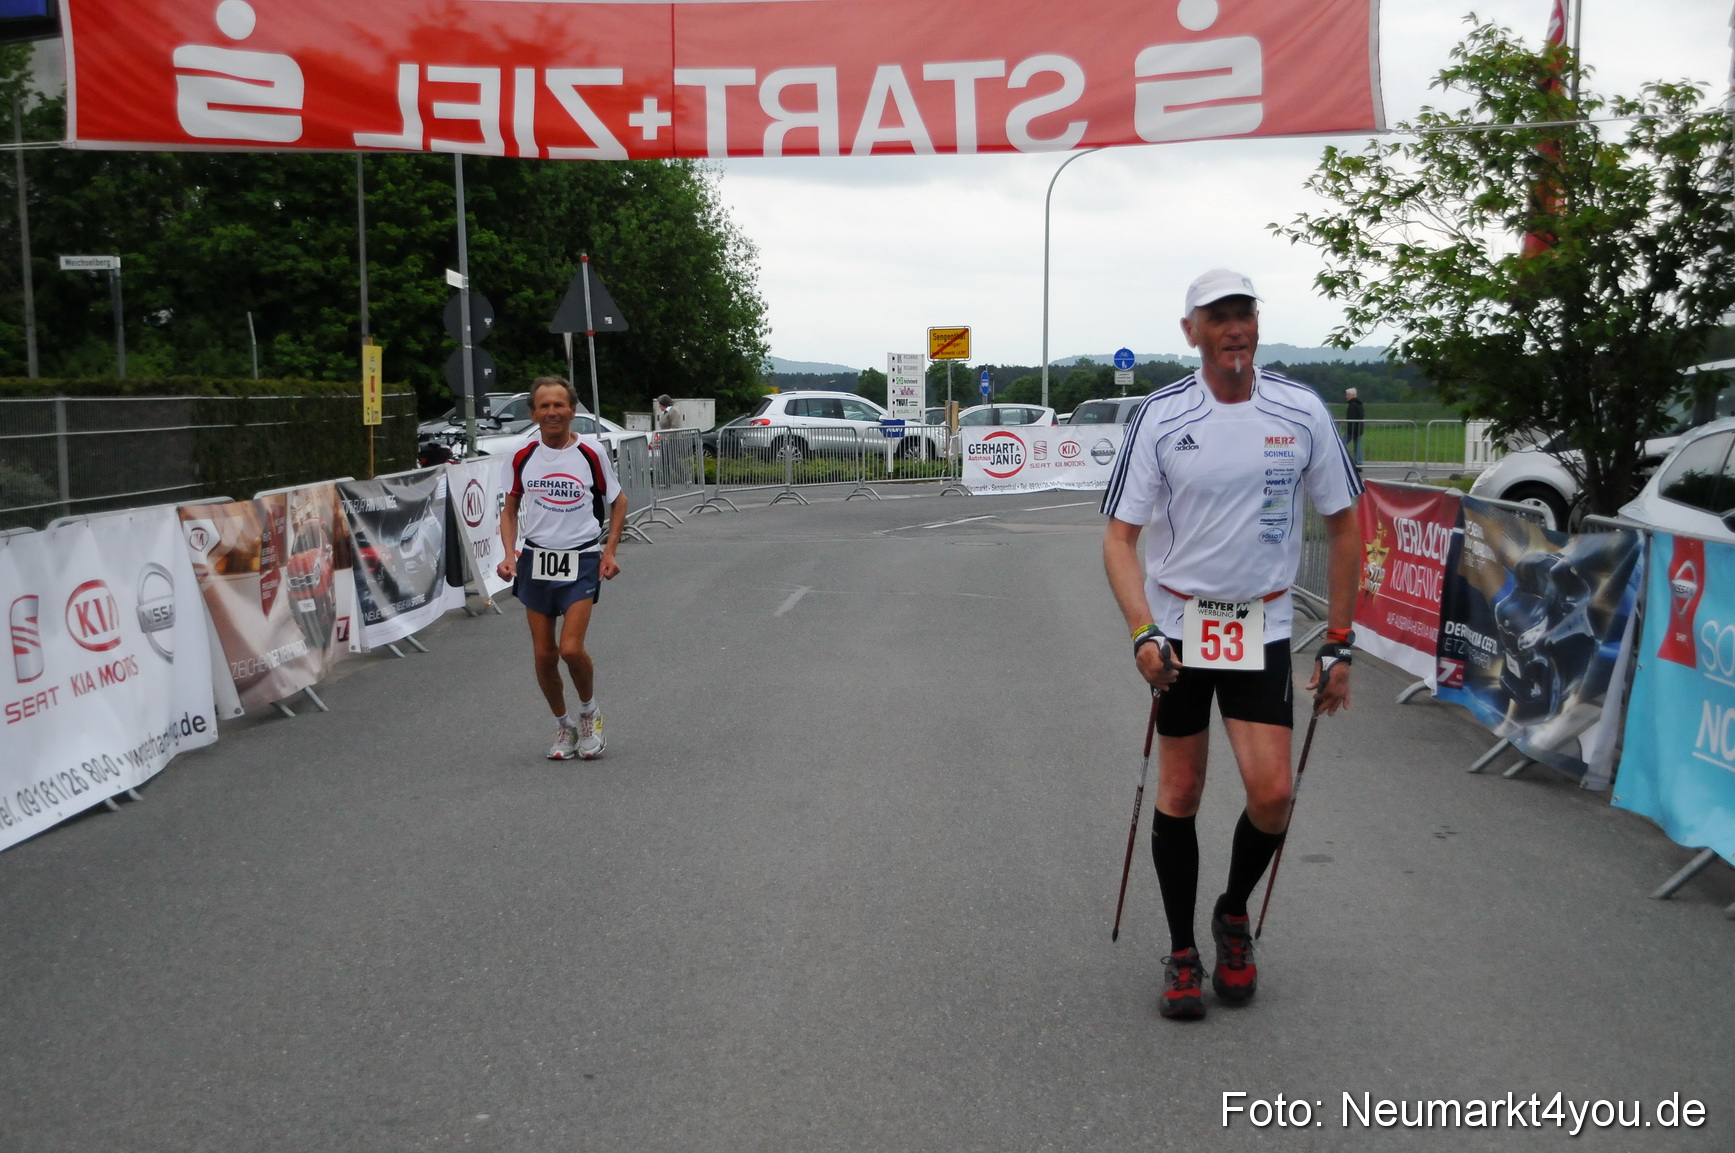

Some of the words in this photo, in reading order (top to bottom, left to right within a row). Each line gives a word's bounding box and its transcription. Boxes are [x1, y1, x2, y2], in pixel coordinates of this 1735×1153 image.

[1174, 443, 1200, 451] adidas
[1264, 436, 1295, 445] MERZ
[968, 443, 1015, 455] GERHART
[1062, 445, 1077, 455] KIA
[1263, 450, 1295, 458] SCHNELL
[527, 480, 575, 489] GERHART
[467, 491, 483, 517] KIA
[471, 537, 491, 559] OTORS
[539, 551, 571, 577] 104
[1198, 600, 1234, 612] MEYER
[1198, 608, 1235, 619] WERBUNG
[1444, 620, 1467, 638] DER
[1200, 619, 1244, 662] 53
[69, 670, 97, 698] KIA
[4, 685, 60, 725] SEAT
[16, 767, 90, 818] 09181/26
[81, 753, 121, 786] 80-0
